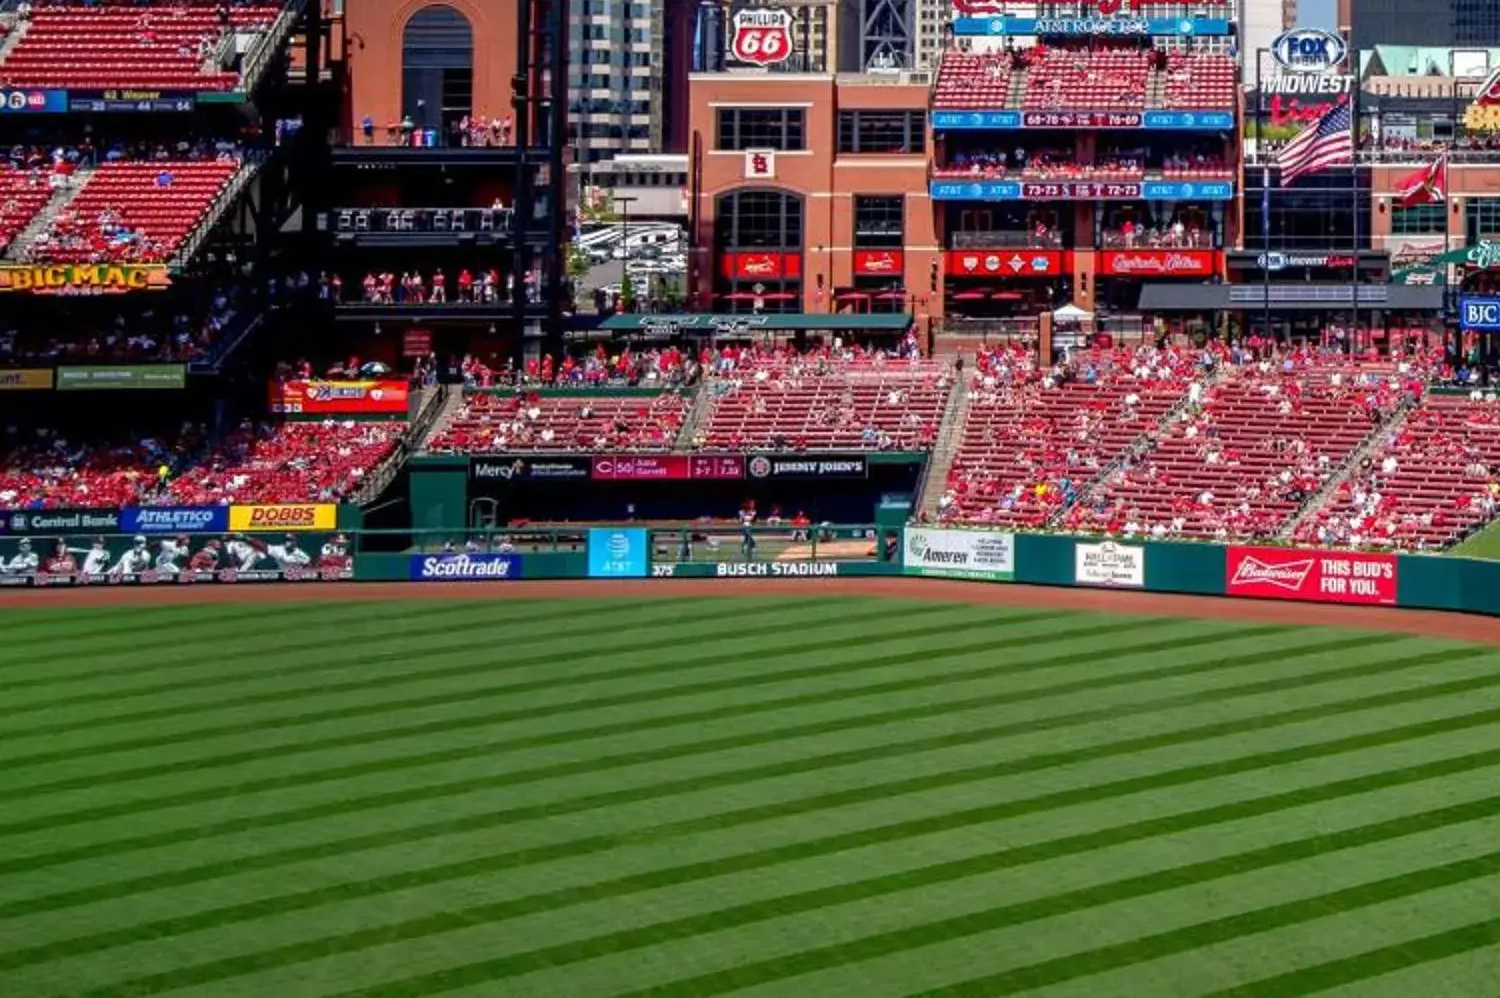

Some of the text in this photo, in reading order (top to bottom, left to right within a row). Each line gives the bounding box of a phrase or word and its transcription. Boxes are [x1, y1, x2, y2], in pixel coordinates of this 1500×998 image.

[740, 13, 785, 25] PHILLIPS
[1035, 20, 1069, 34] AT&T
[741, 31, 782, 54] 66
[1287, 37, 1330, 54] FOX
[1260, 74, 1355, 93] MIDWEST
[12, 264, 148, 289] BIG MAC
[1467, 305, 1498, 323] BJC
[475, 464, 513, 479] Mercy
[774, 460, 863, 474] JIMMY JOHN'S
[31, 514, 118, 528] Central Bank
[135, 509, 214, 524] ATHLETICO
[251, 507, 316, 522] DOBBS
[922, 548, 969, 564] Ameren
[422, 553, 510, 577] Scottrade
[602, 561, 632, 572] AT&T
[652, 565, 676, 577] 375
[717, 561, 838, 575] BUSCH STADIUM
[1240, 559, 1393, 580] Budweiser THIS BUD'S
[1321, 578, 1380, 595] FOR YOU.
